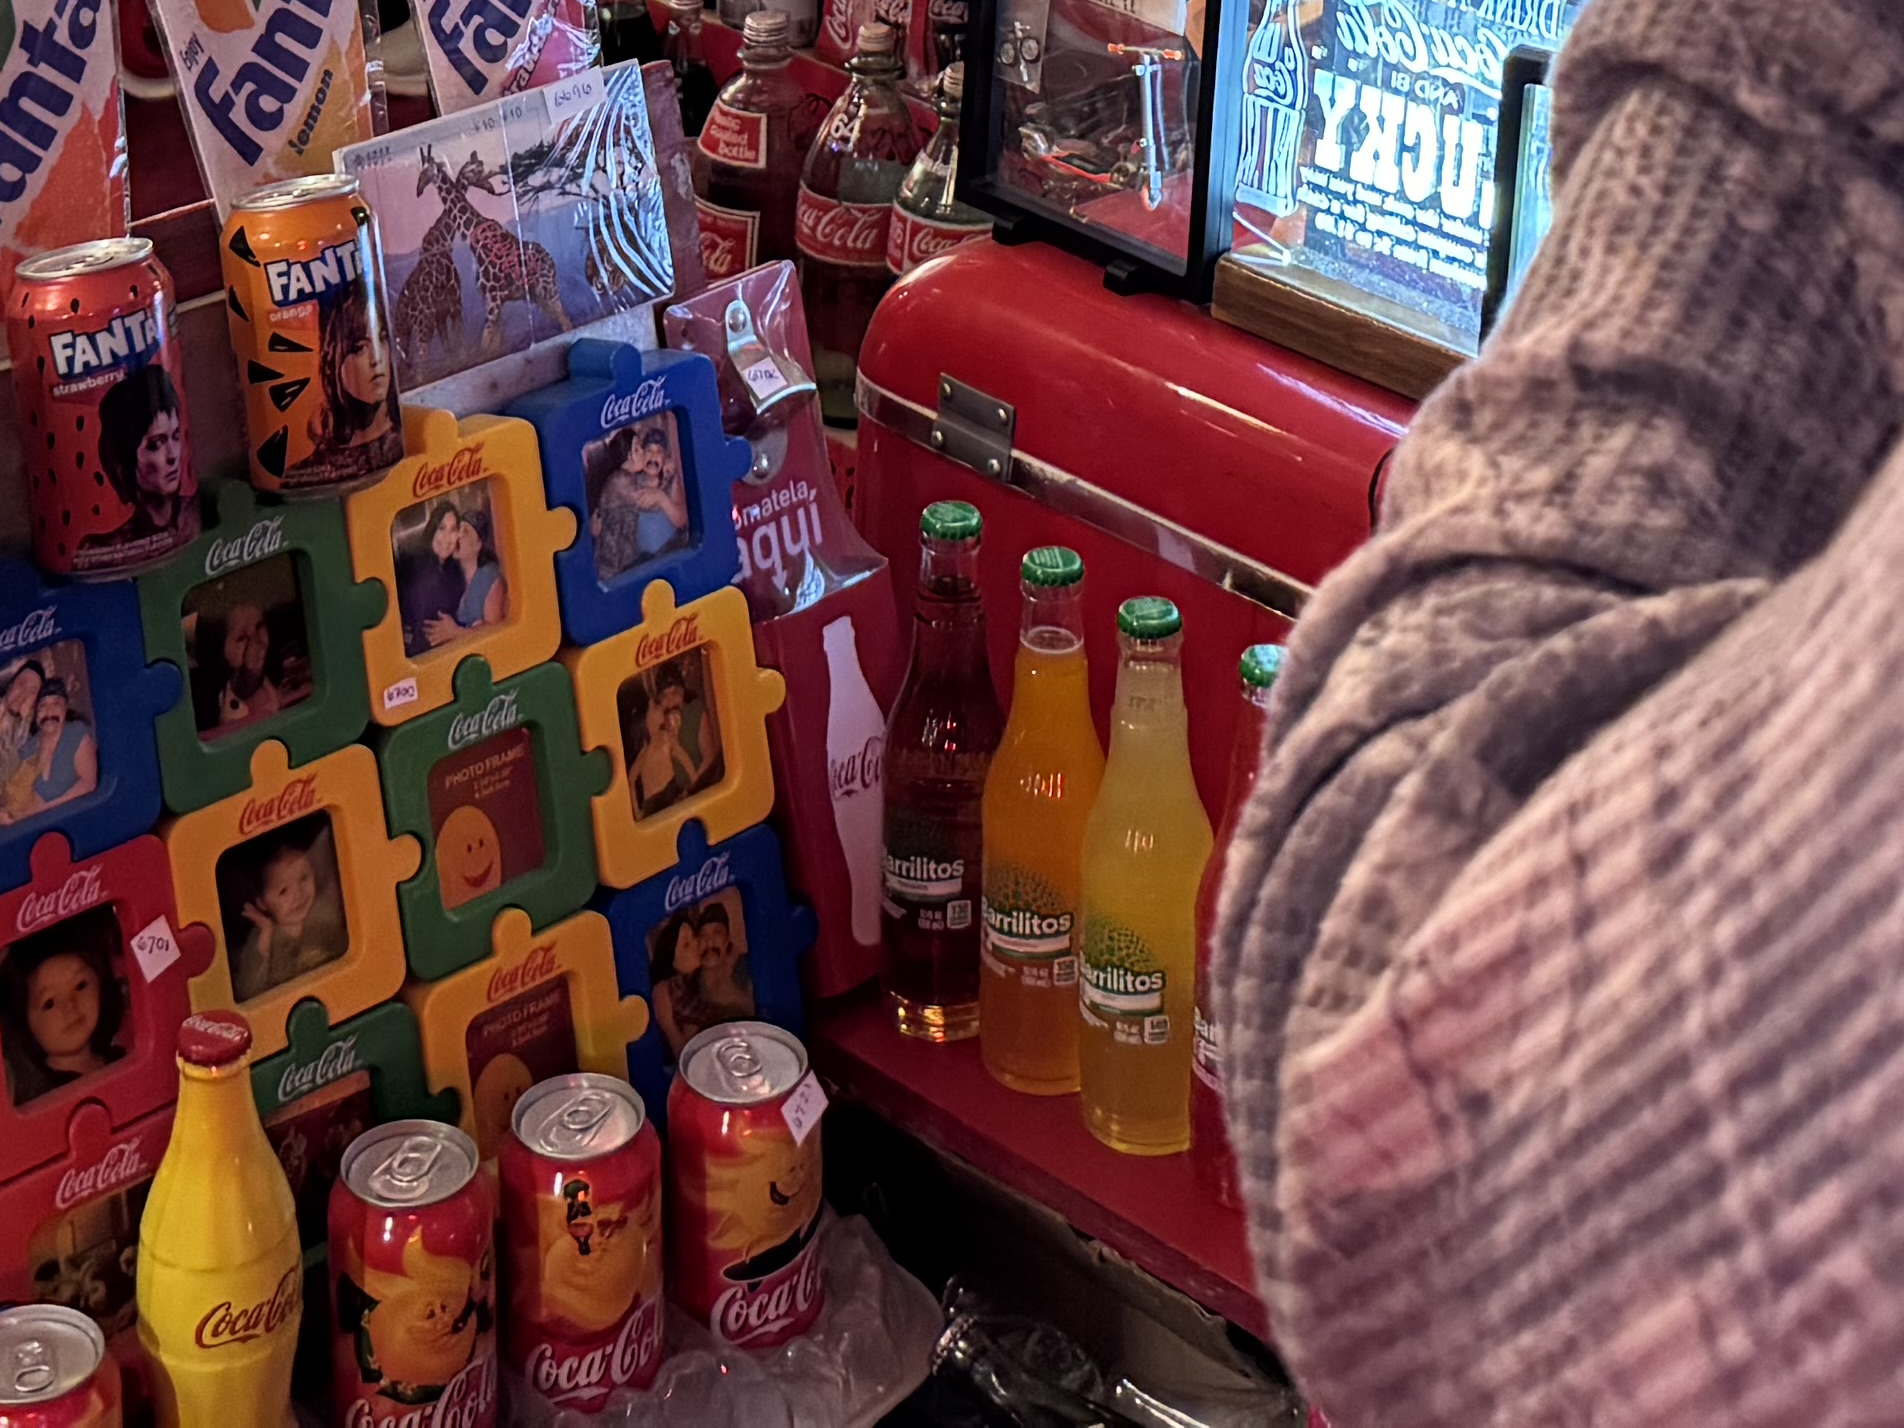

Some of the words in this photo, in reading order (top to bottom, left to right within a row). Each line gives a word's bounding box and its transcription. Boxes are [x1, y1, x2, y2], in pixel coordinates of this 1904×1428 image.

[181, 31, 205, 73] Enjoy
[289, 68, 335, 157] lemon
[831, 116, 859, 139] 64
[718, 142, 756, 161] bottle
[51, 310, 162, 378] FANTA
[52, 370, 123, 397] strawberry
[446, 769, 479, 791] PHOTO
[480, 745, 526, 775] FRAME
[136, 937, 170, 954] 6701
[520, 992, 571, 1022] FRAME
